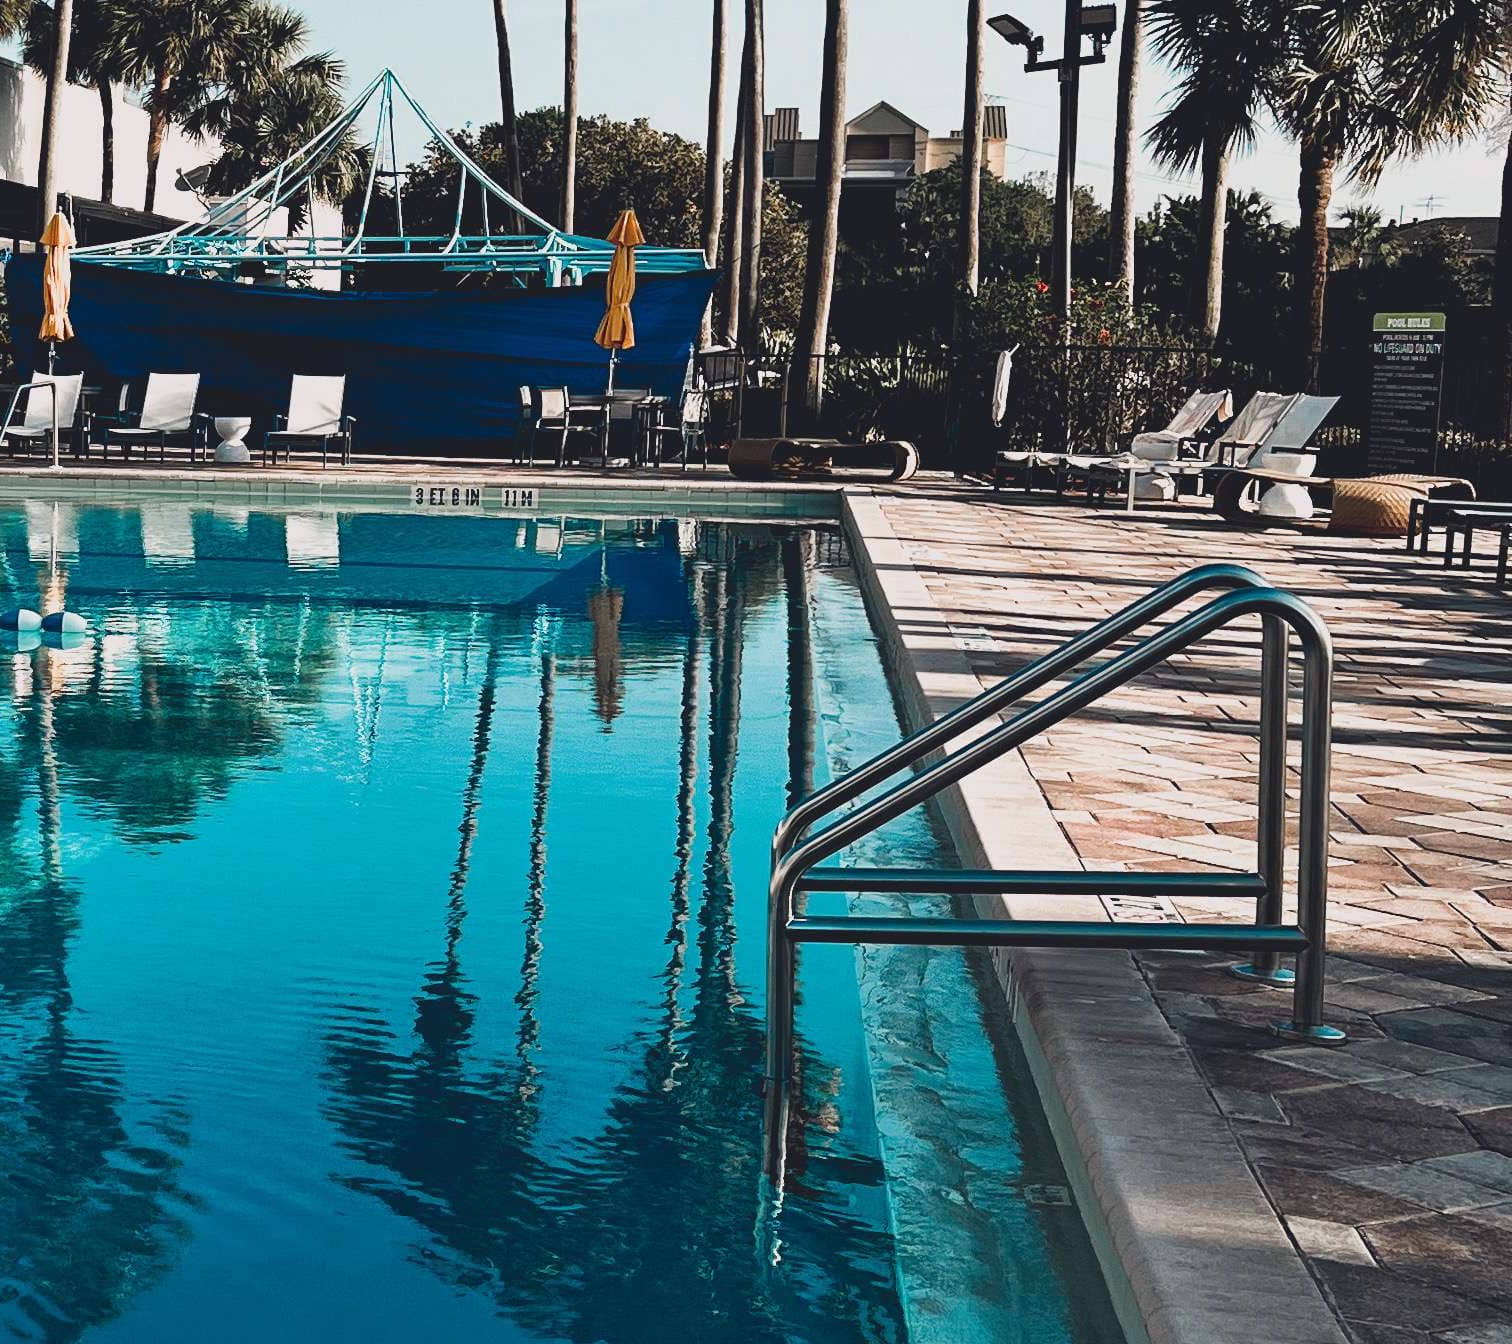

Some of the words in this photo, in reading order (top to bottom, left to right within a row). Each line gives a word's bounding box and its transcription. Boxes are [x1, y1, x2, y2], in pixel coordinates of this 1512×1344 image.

[1387, 318, 1406, 328] POOL
[1407, 318, 1431, 328] RULES
[1425, 343, 1442, 354] DUTY
